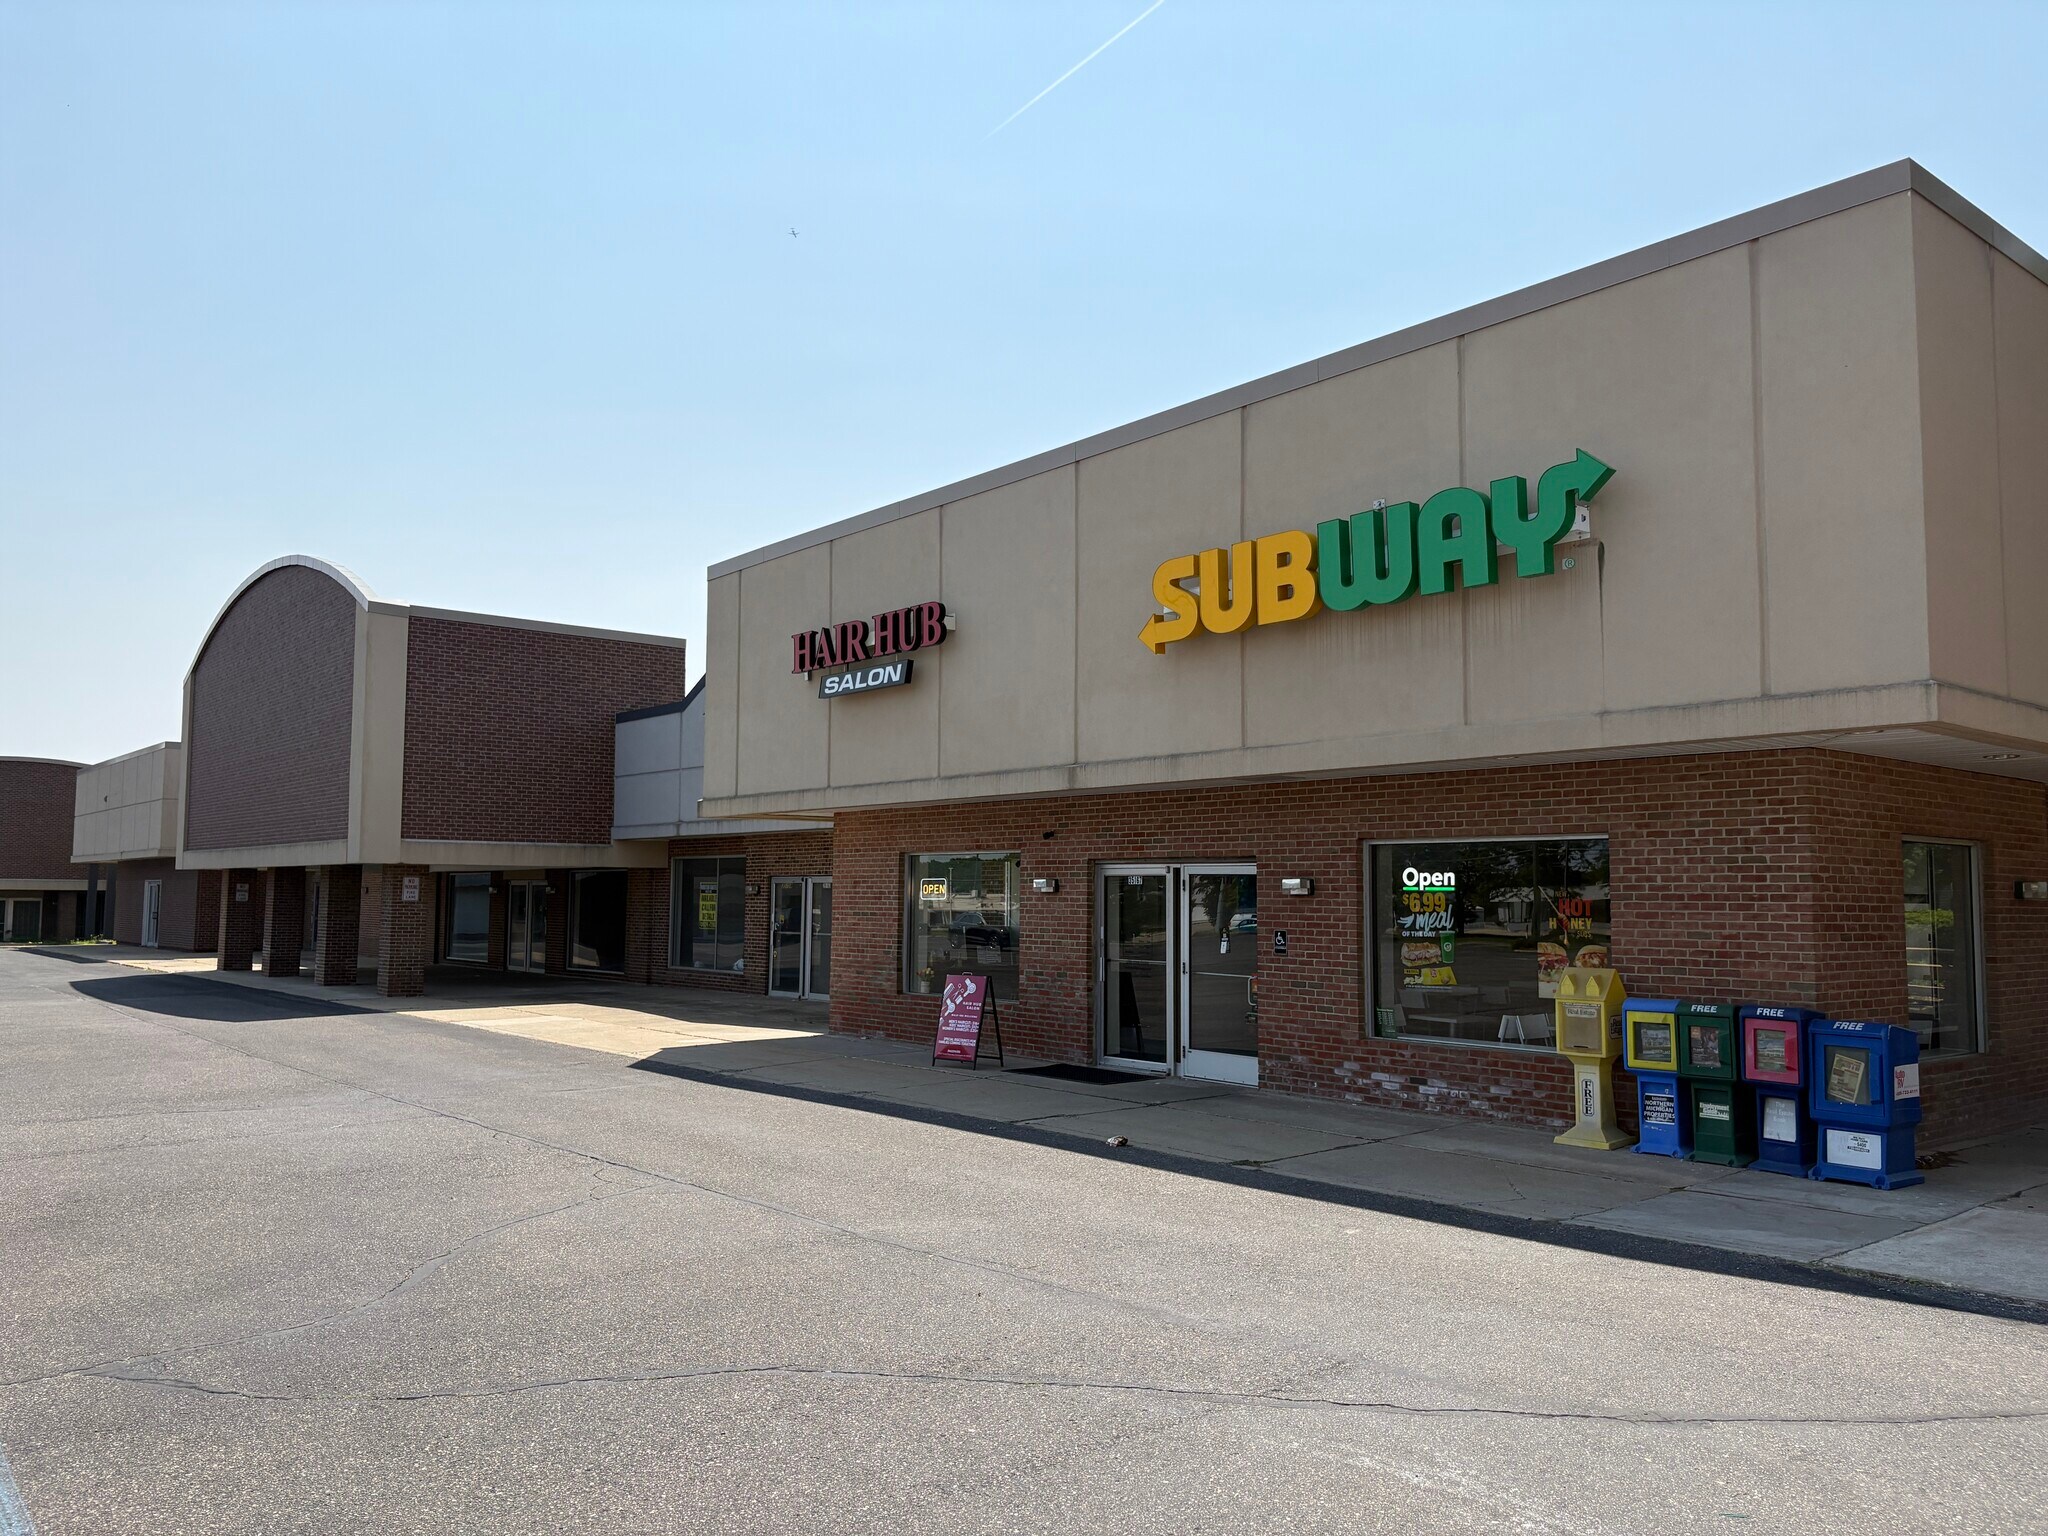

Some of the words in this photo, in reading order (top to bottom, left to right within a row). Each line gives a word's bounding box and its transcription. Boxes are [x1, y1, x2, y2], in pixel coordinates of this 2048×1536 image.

[1137, 448, 1616, 654] SUBWAY
[791, 620, 869, 674] HAIR
[872, 601, 946, 657] HUB
[824, 663, 902, 694] SALON
[1402, 867, 1455, 891] Open
[923, 884, 946, 895] OPEN
[1402, 892, 1446, 913] $6.99
[1558, 897, 1592, 917] HOT
[1415, 904, 1454, 932] meal
[1549, 917, 1592, 930] HNEY
[1691, 1004, 1718, 1013] FREE
[1756, 1007, 1785, 1017] FREE
[1833, 1021, 1865, 1031] FREE
[1644, 1111, 1675, 1119] PROPERTIES
